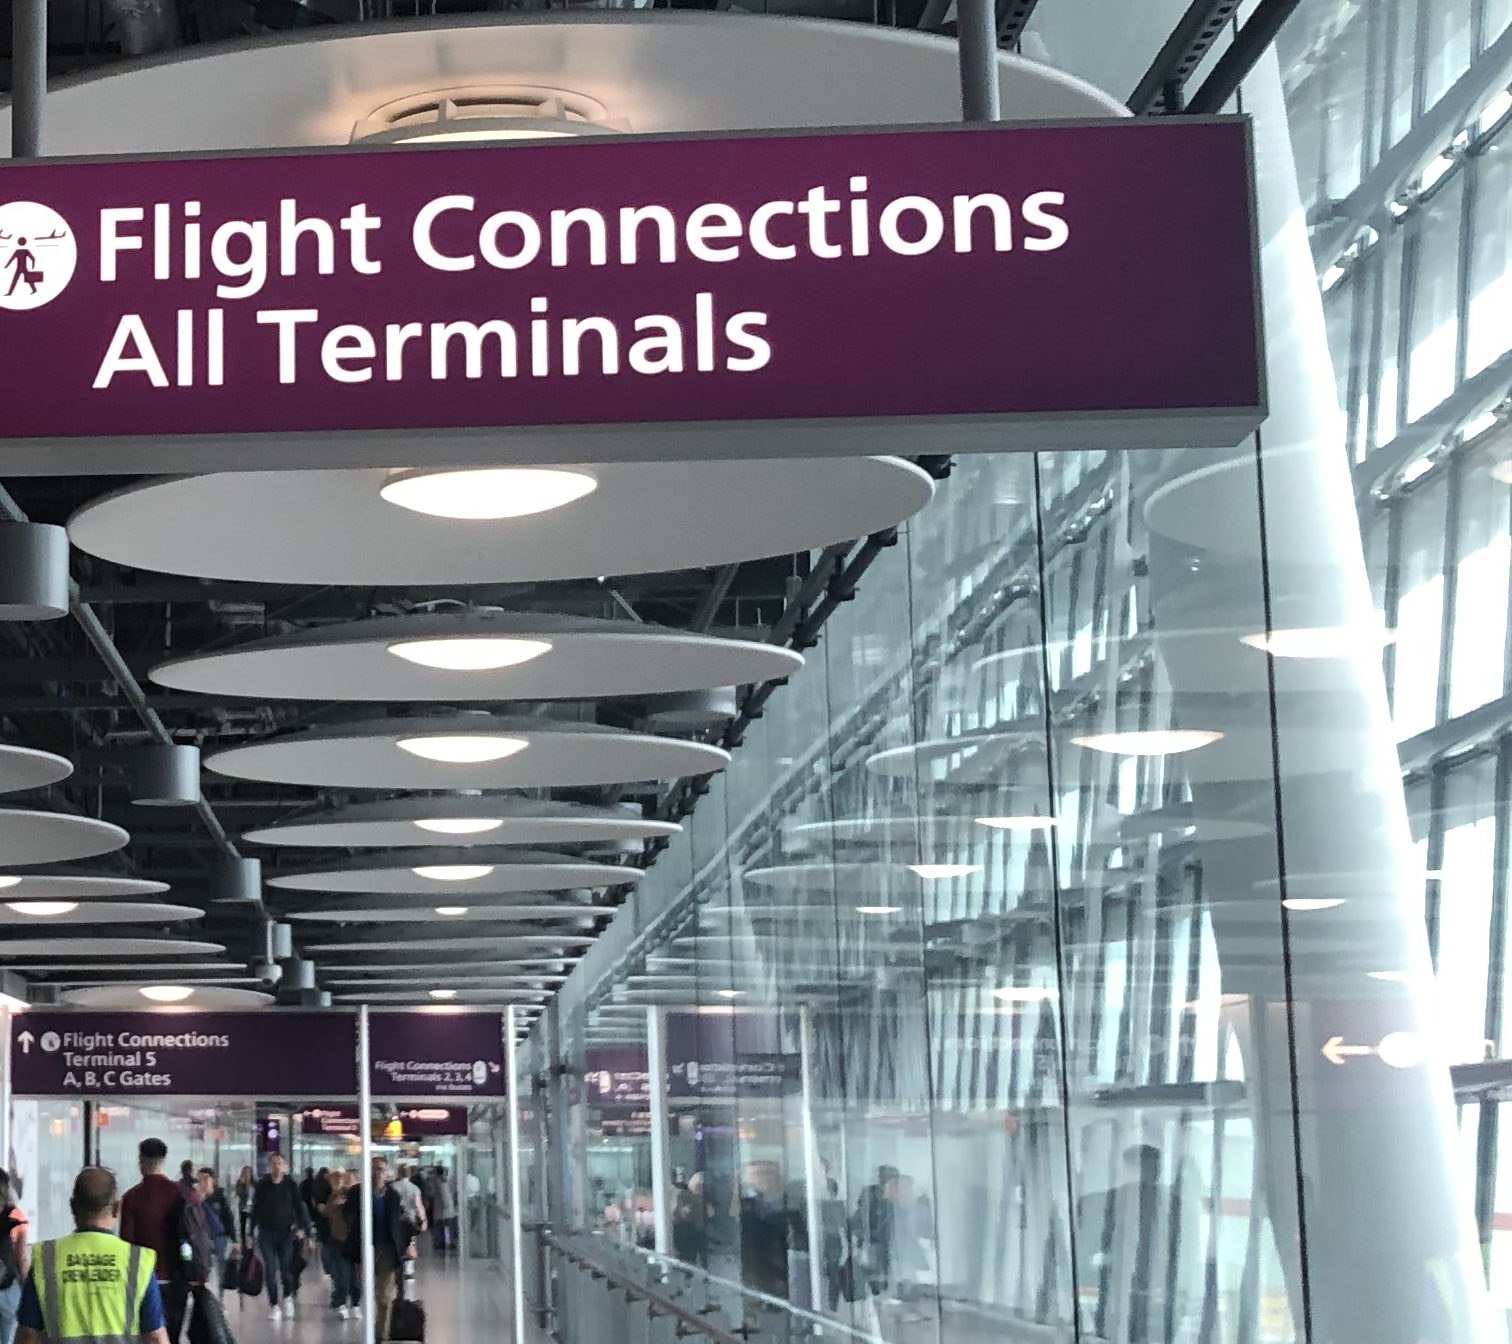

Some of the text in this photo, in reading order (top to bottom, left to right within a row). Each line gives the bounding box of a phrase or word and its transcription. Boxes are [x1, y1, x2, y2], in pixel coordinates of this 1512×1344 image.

[100, 175, 1069, 299] Flight Connections
[92, 293, 771, 389] All Terminals
[63, 1031, 230, 1052] Flight Connections
[63, 1051, 157, 1067] Terminal 5
[62, 1071, 82, 1088] A,
[103, 1071, 117, 1086] C
[119, 1070, 172, 1087] Gates
[66, 1253, 117, 1267] BAGGAGE
